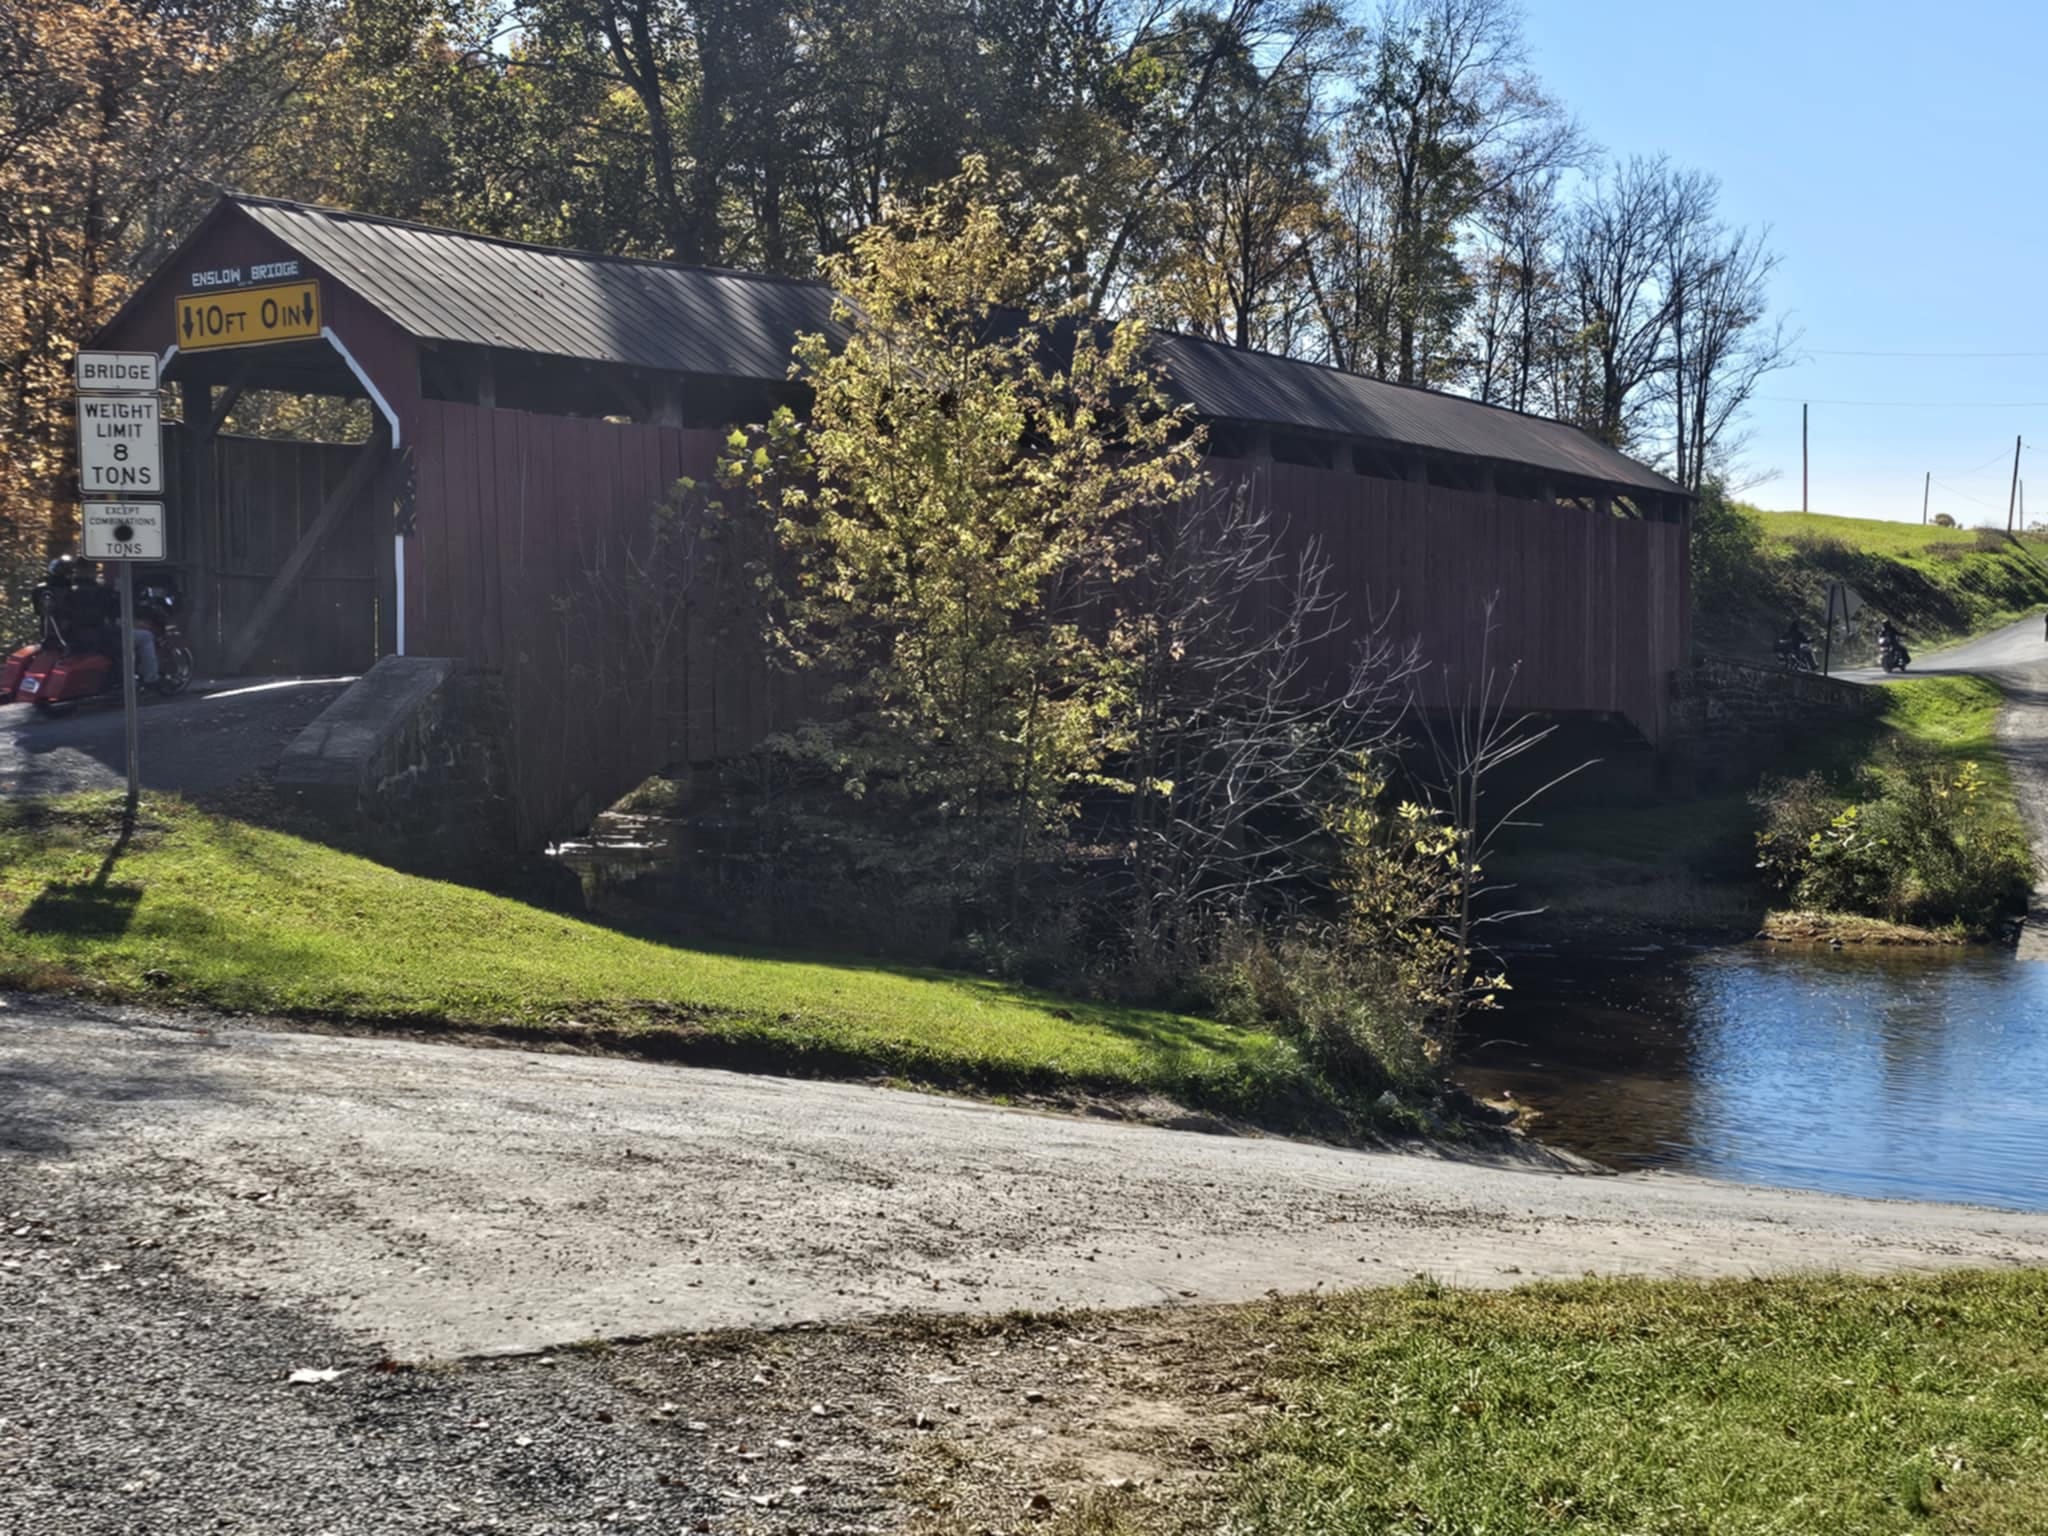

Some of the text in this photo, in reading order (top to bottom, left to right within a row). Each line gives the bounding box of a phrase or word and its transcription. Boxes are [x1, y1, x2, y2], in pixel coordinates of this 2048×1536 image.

[192, 261, 299, 287] ENSLOW BRIDGE
[84, 363, 151, 380] BRIDGE
[85, 403, 153, 419] WEIGHT
[96, 423, 143, 438] LIMIT
[113, 443, 129, 461] 8
[92, 466, 152, 485] TONS
[105, 506, 140, 515] EXCEPT
[89, 517, 156, 526] COMBINATIONS
[106, 543, 143, 554] TONS
